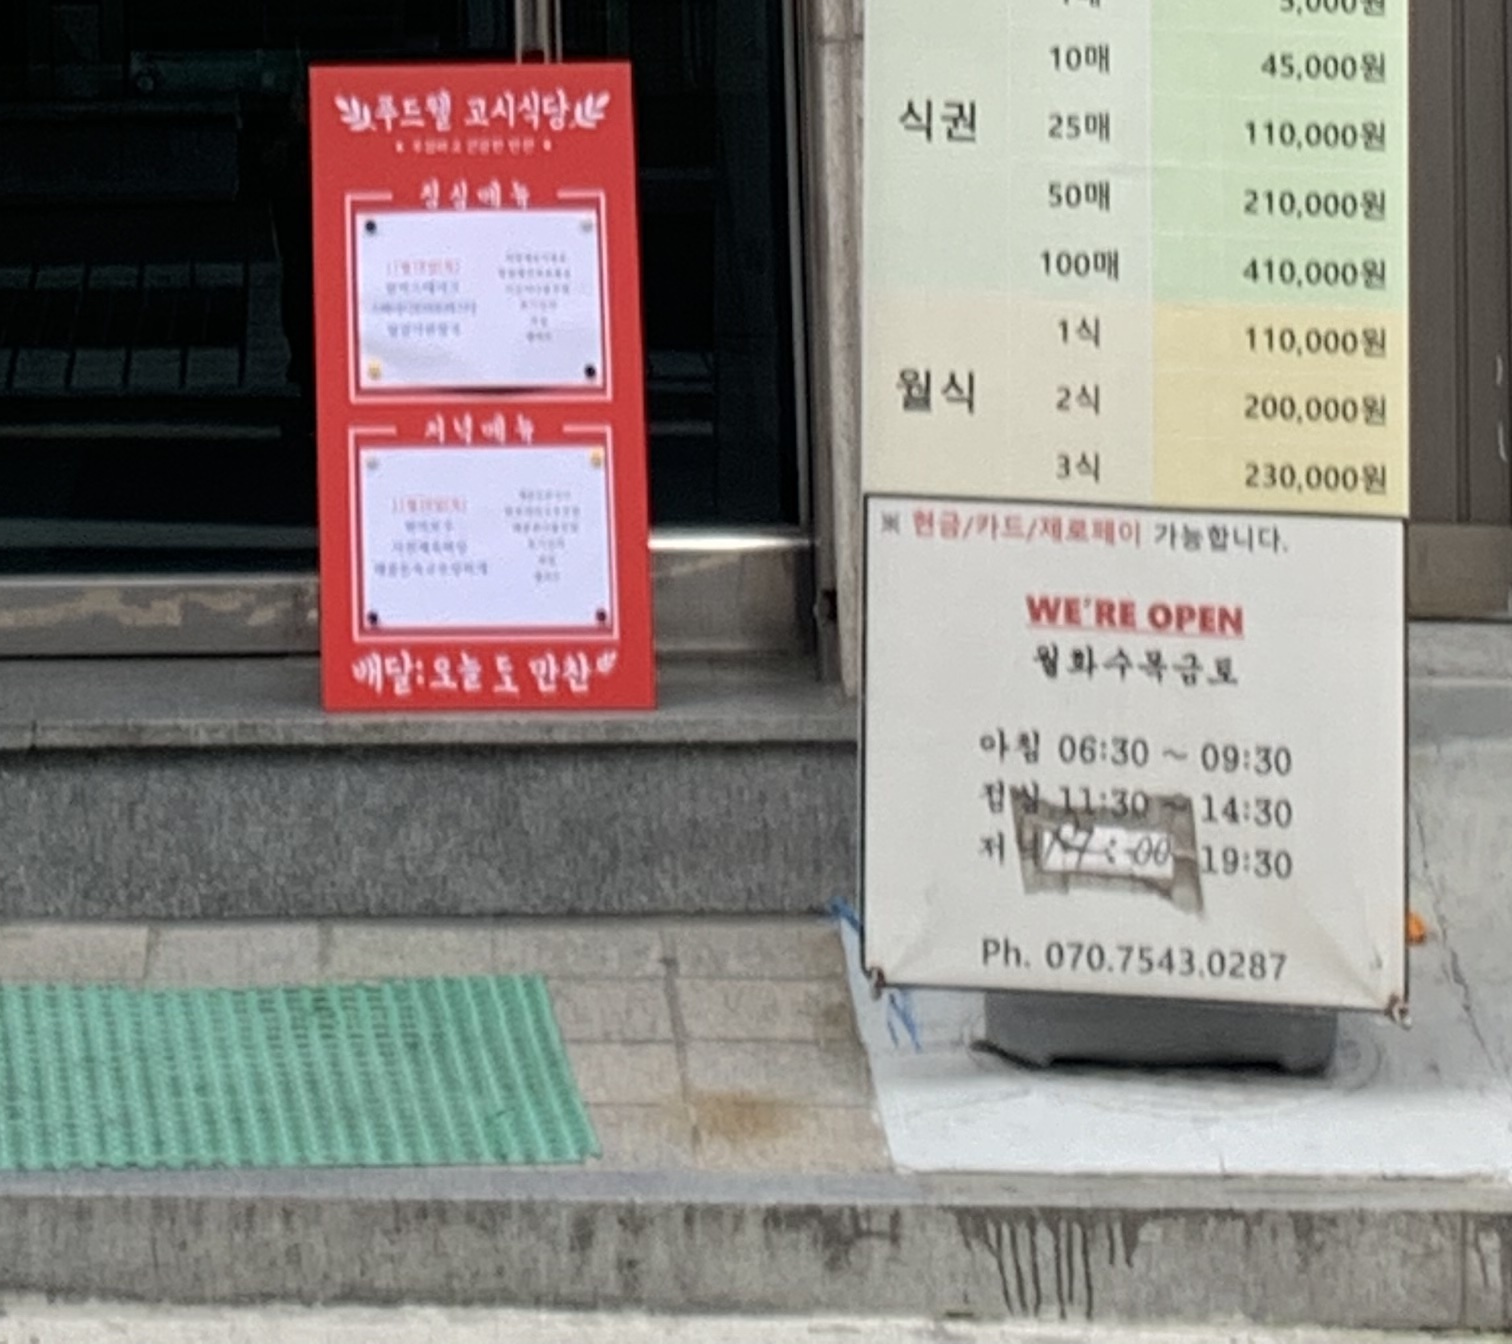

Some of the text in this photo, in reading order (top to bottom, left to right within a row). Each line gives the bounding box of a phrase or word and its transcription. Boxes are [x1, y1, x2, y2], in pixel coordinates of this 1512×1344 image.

[1049, 44, 1110, 73] 10매
[1261, 52, 1387, 83] 45,000원
[375, 88, 570, 132] 푸드웰 고시식당
[899, 100, 976, 142] 식권
[1048, 113, 1111, 142] 25매
[1245, 120, 1387, 151] 110,000원
[1048, 182, 1111, 211] 50매
[1244, 188, 1387, 220] 210,000원
[1040, 251, 1119, 281] 100매
[1242, 257, 1387, 289] 410,000원
[1058, 317, 1101, 346] 1식
[1245, 327, 1387, 358] 110,000원
[897, 369, 975, 412] 월식
[1056, 385, 1101, 415] 2식
[1244, 395, 1387, 427] 200,000원
[1056, 453, 1101, 483] 3식
[1245, 463, 1387, 495] 230,000원
[1154, 522, 1289, 554] 가능합니다.
[1025, 595, 1244, 636] WE'RE OPEN
[980, 728, 1039, 762] 아침
[1059, 735, 1149, 766] 06:30
[1201, 742, 1292, 776] 09:30
[1060, 786, 1150, 819] 11:30
[1201, 794, 1293, 824] 14:30
[1201, 846, 1293, 879] 19:30
[981, 939, 1287, 980] Ph. 070.7543.0287
